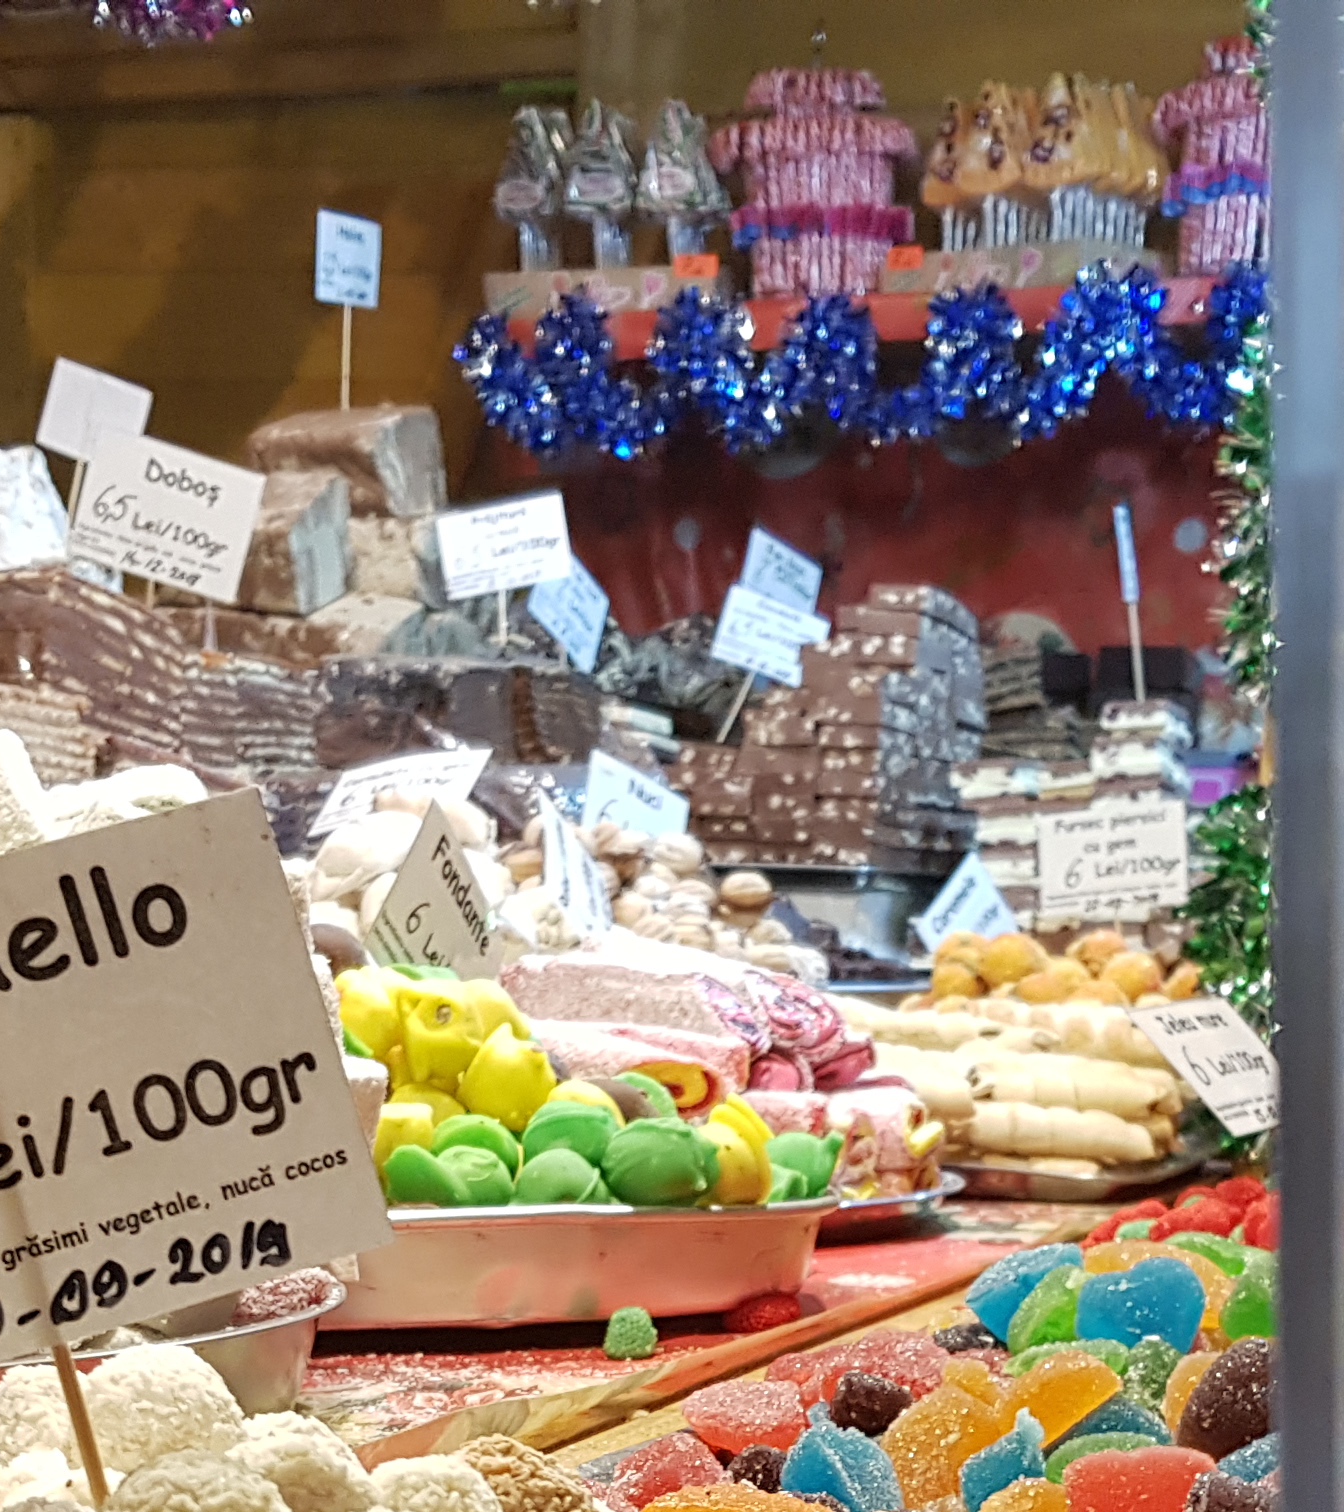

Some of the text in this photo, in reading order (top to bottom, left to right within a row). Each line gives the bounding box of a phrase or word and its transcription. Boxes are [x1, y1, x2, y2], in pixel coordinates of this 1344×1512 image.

[145, 457, 222, 507] Doboș
[131, 511, 229, 559] Lei/100gr
[431, 834, 491, 957] Fondante
[1064, 856, 1181, 889] 6 Lei/100gr
[406, 903, 430, 934] 6
[1182, 1045, 1211, 1086] 6
[1, 1220, 89, 1271] grăsimi
[98, 1191, 211, 1236] vegetale,
[221, 1165, 276, 1201] nucă
[285, 1148, 349, 1182] cocos
